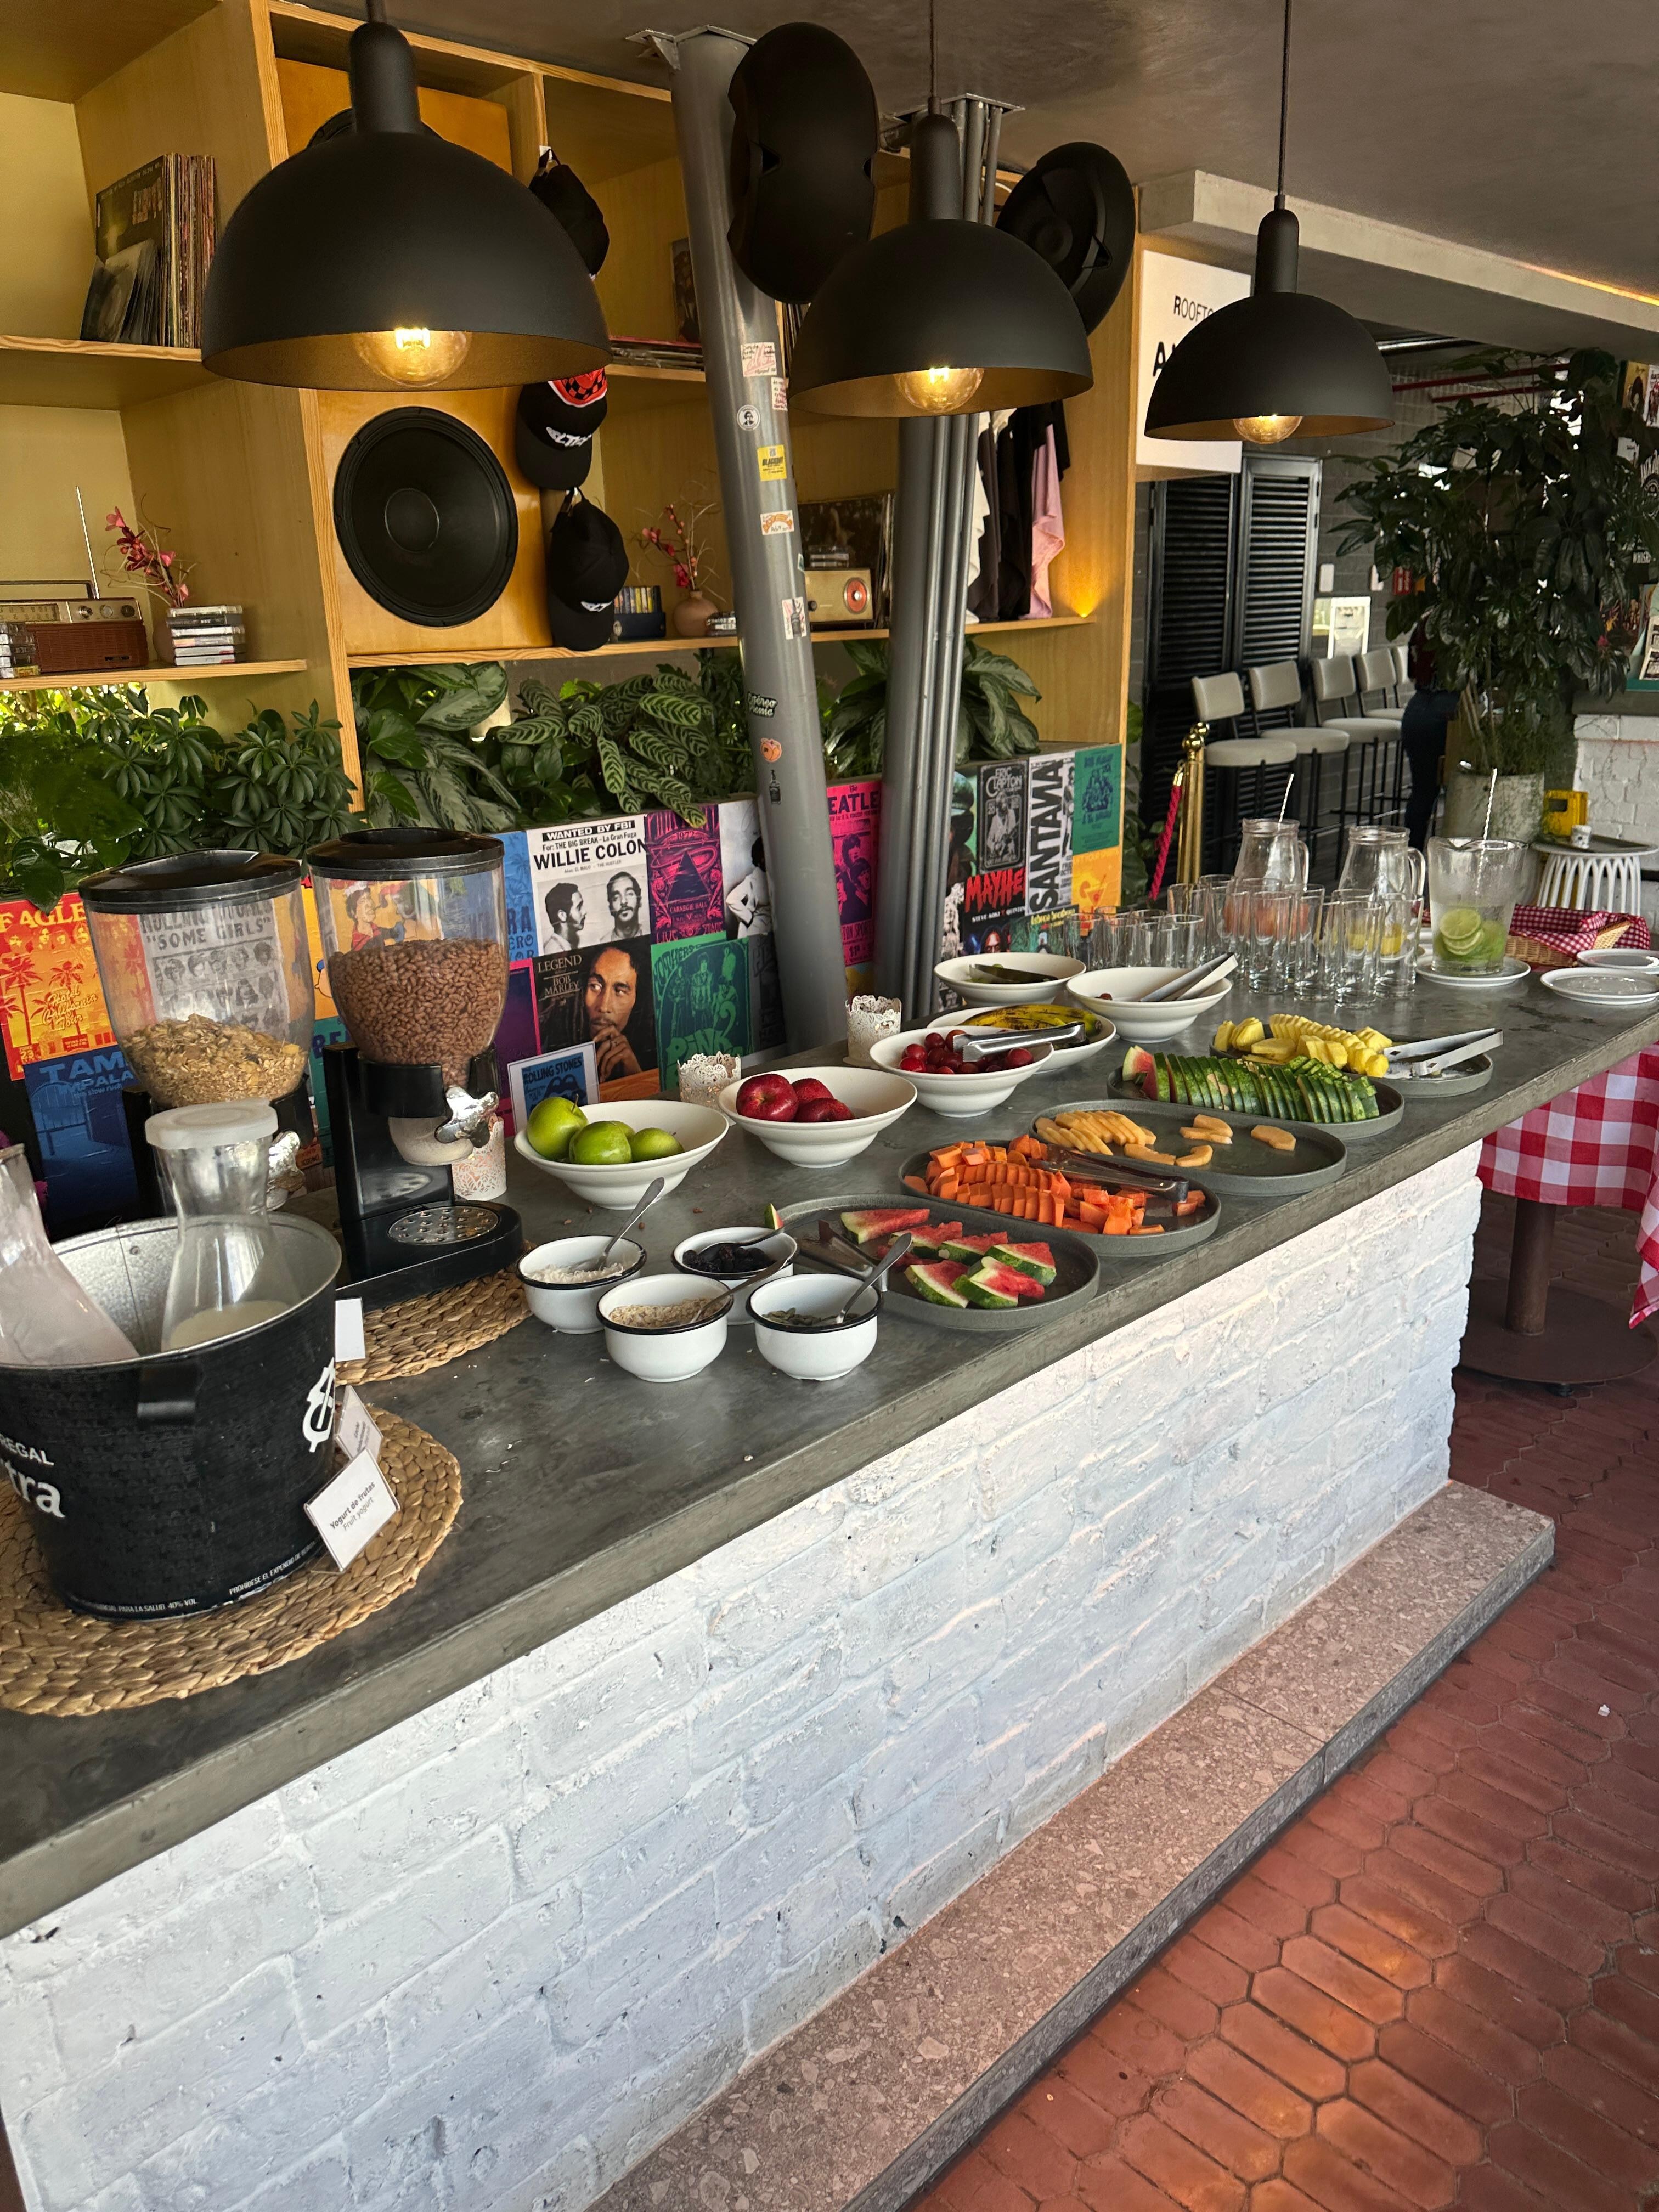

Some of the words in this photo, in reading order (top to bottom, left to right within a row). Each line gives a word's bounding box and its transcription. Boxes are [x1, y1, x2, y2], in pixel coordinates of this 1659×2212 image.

[1173, 295, 1214, 322] ROOFT
[827, 790, 879, 815] EATLE
[546, 827, 592, 841] WANTED
[597, 823, 611, 834] BY
[614, 821, 632, 831] FBI
[555, 842, 567, 850] THE
[568, 839, 578, 848] BIG
[579, 837, 599, 846] BREAK
[610, 833, 623, 842] Gran
[624, 831, 637, 840] Fuga
[1029, 759, 1063, 912] SANTANA
[533, 847, 591, 871] WILLIE
[595, 838, 647, 860] COLON
[965, 867, 1026, 913] MAYHE
[508, 906, 532, 935] RA
[538, 955, 583, 973] LEGEND
[544, 981, 580, 997] MARLEY
[553, 975, 572, 986] BOB
[48, 985, 80, 1006] Hotel
[55, 1014, 83, 1030] Tour
[40, 1051, 126, 1082] TAM
[523, 1065, 555, 1085] ROLLING
[556, 1057, 583, 1075] STONES
[59, 1070, 134, 1095] MPALA
[0, 1458, 66, 1519] tra
[330, 1506, 352, 1530] Yogurt
[351, 1499, 359, 1510] de
[358, 1482, 376, 1502] frutas
[343, 1515, 358, 1532] Fruit
[356, 1497, 374, 1519] yogurt
